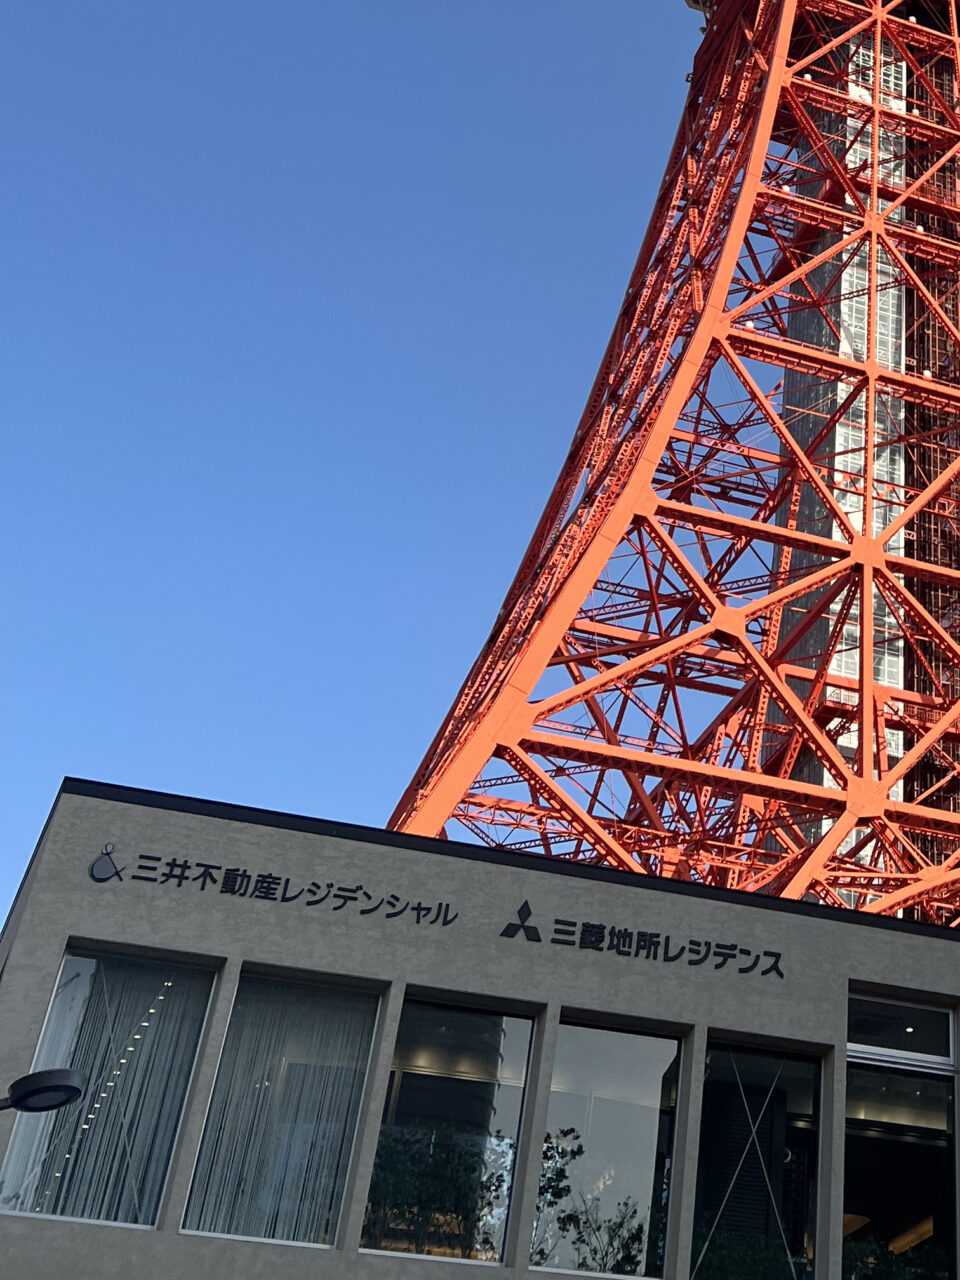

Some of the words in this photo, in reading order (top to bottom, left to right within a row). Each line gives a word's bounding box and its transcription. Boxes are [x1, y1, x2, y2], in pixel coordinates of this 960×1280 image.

[131, 854, 459, 926] 三井不動産レジデンシャル
[551, 918, 785, 979] 三菱地所レジデンス
